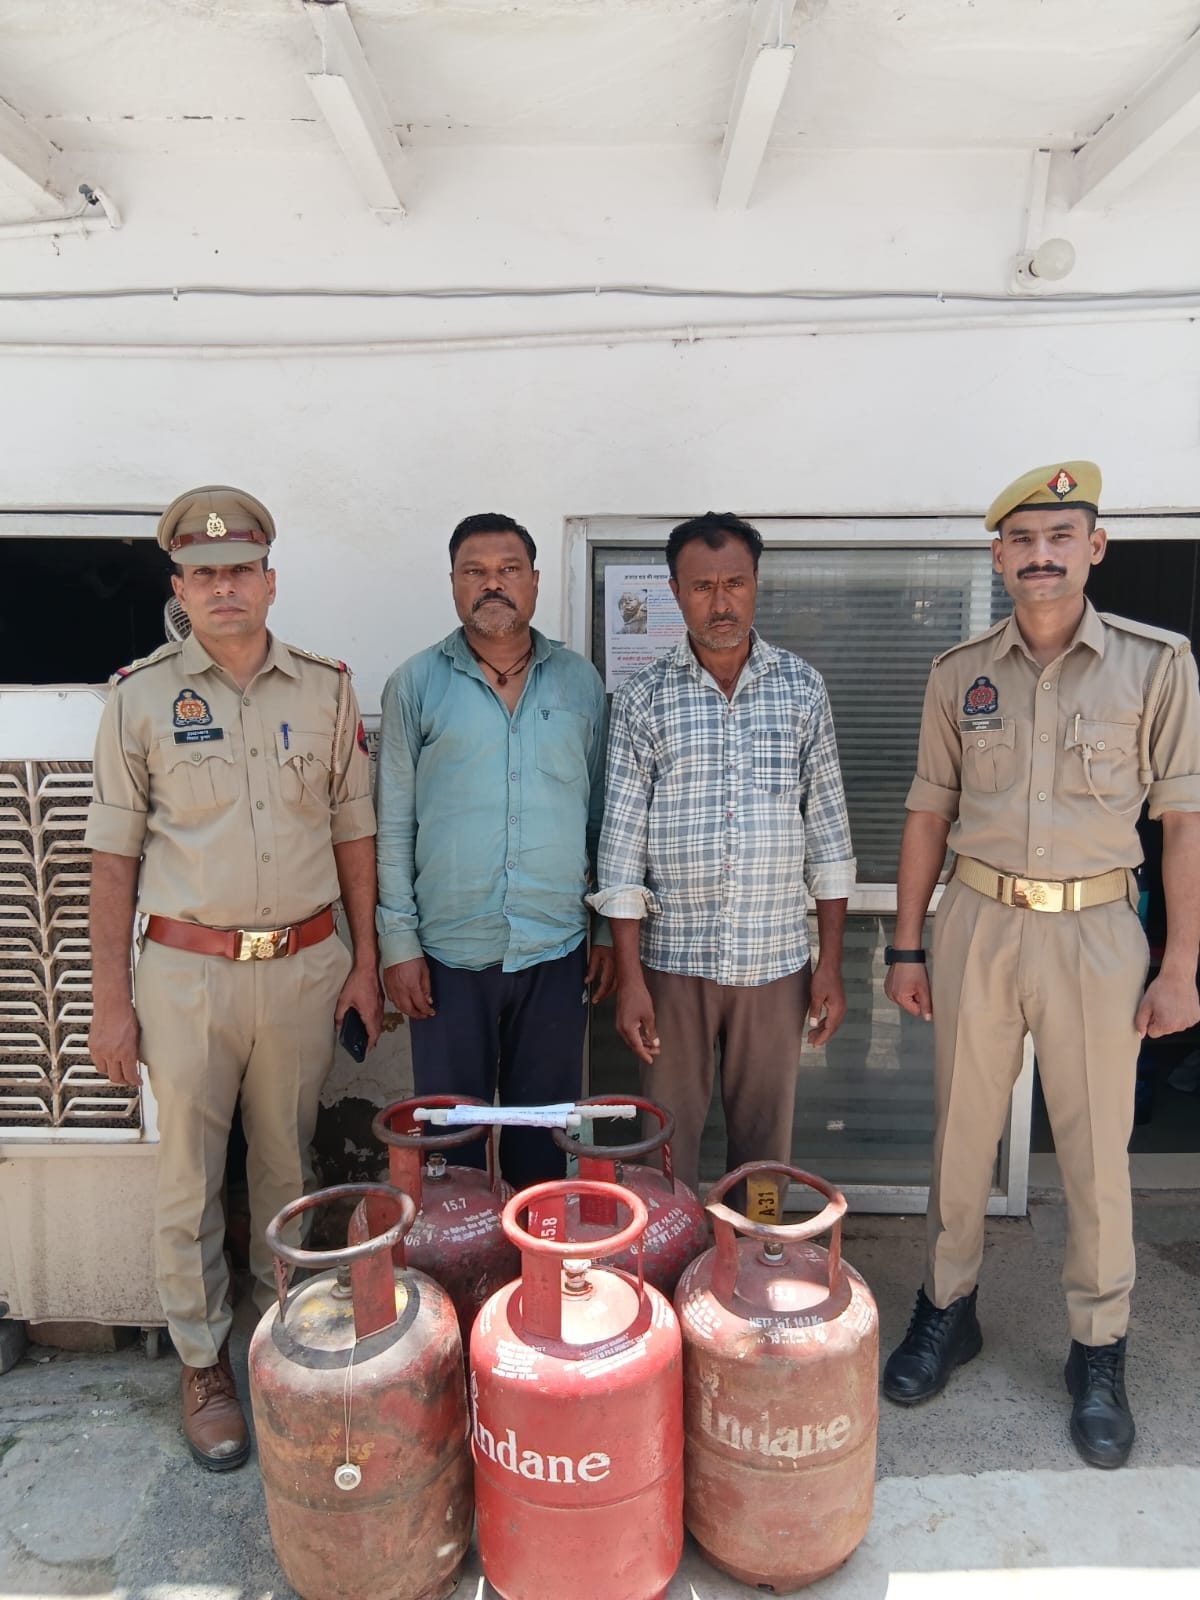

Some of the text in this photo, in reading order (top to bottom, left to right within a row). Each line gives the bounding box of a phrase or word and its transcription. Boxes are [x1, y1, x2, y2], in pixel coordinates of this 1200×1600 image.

[442, 1197, 467, 1212] 15.7
[404, 1234, 421, 1246] 06
[749, 1317, 772, 1328] NETT
